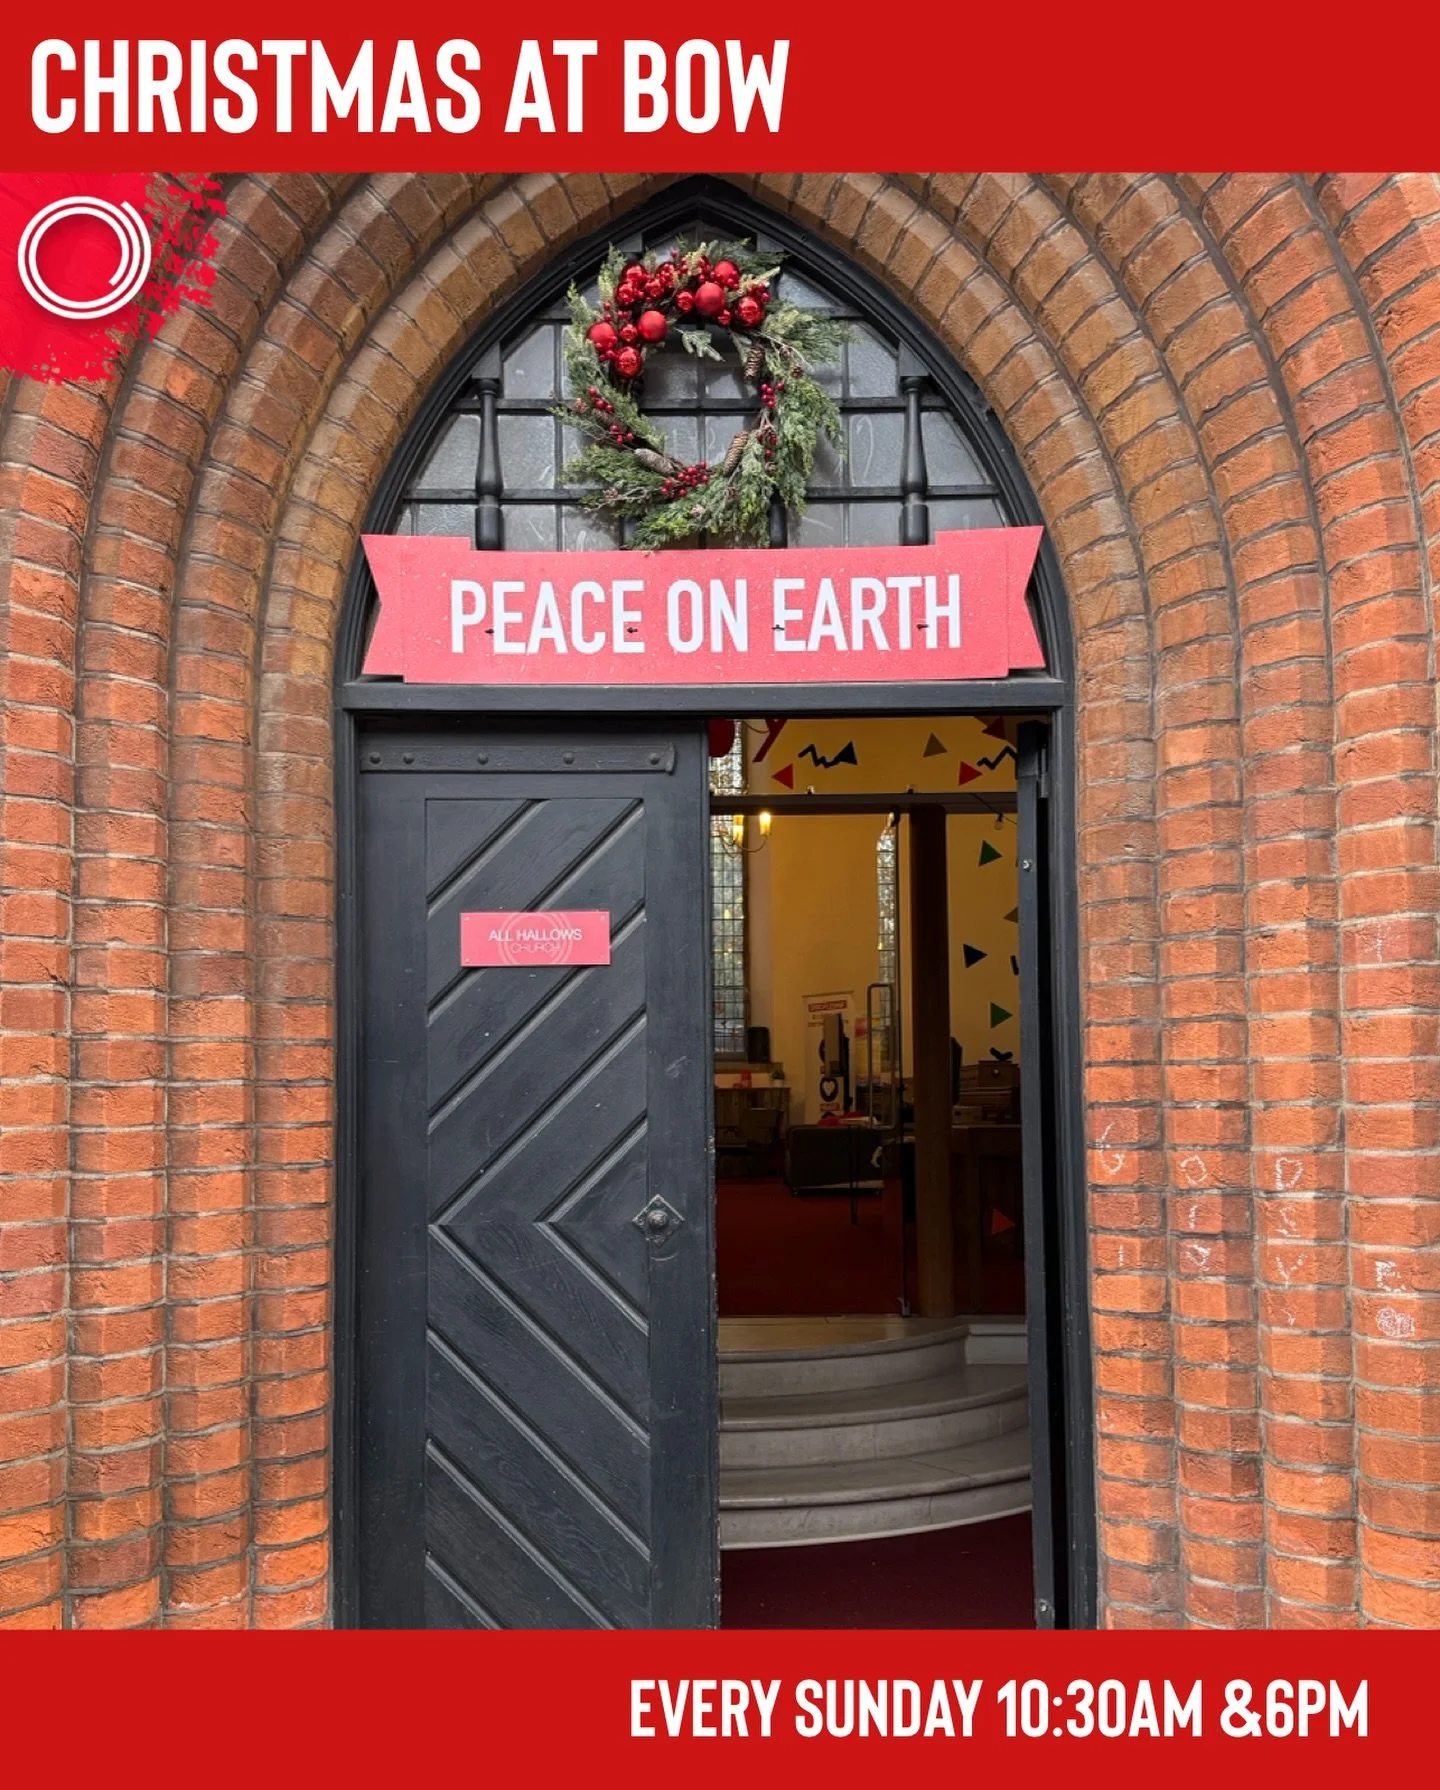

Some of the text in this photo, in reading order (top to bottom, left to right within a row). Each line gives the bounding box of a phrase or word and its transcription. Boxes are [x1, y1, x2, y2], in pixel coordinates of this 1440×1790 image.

[450, 574, 961, 655] PEACE ON EARTH
[488, 928, 582, 941] ALL HALLOWS
[512, 943, 561, 953] CHURCH
